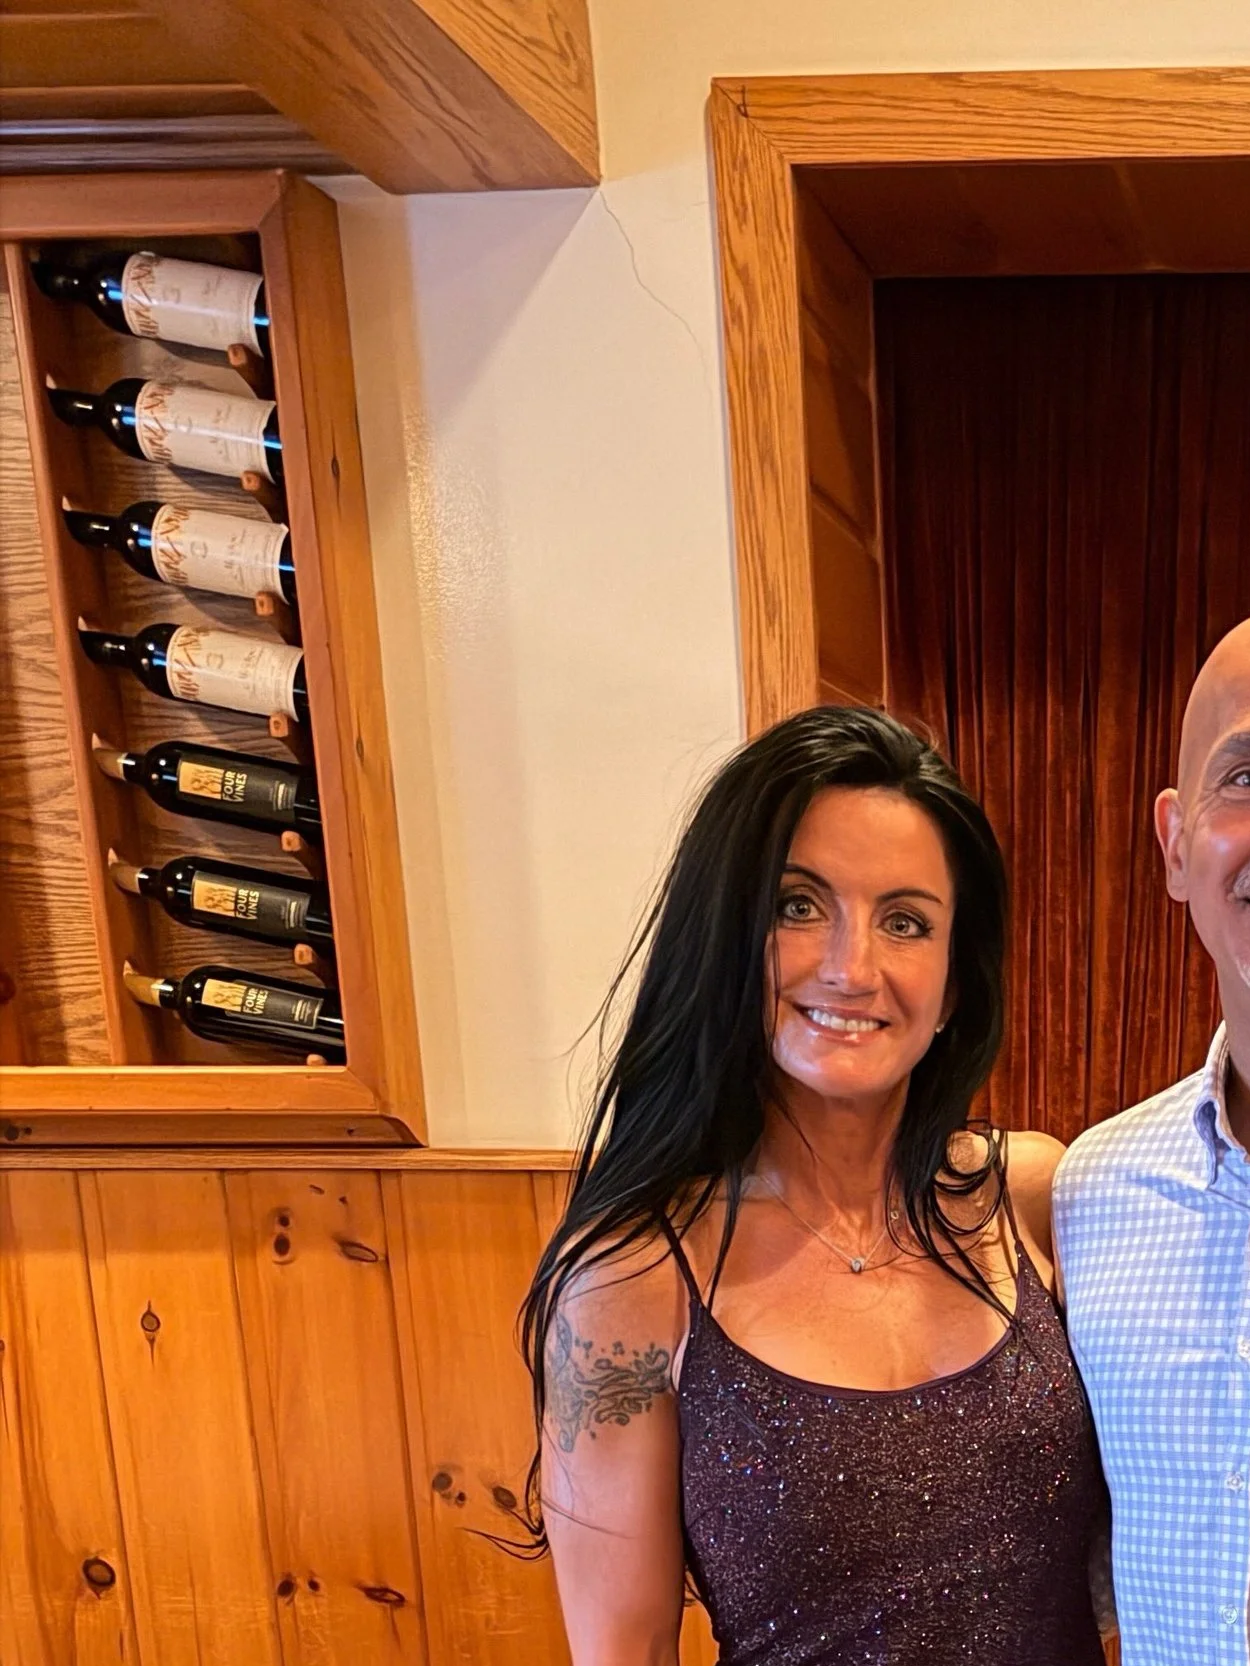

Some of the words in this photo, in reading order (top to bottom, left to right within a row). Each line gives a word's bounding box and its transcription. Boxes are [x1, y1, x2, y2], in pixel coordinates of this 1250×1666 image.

[222, 770, 237, 801] FOUR
[232, 773, 248, 802] VINES
[236, 888, 250, 918] FOUR
[246, 890, 260, 920] VINES
[242, 987, 259, 1014] FOUR
[253, 989, 269, 1015] VINES
